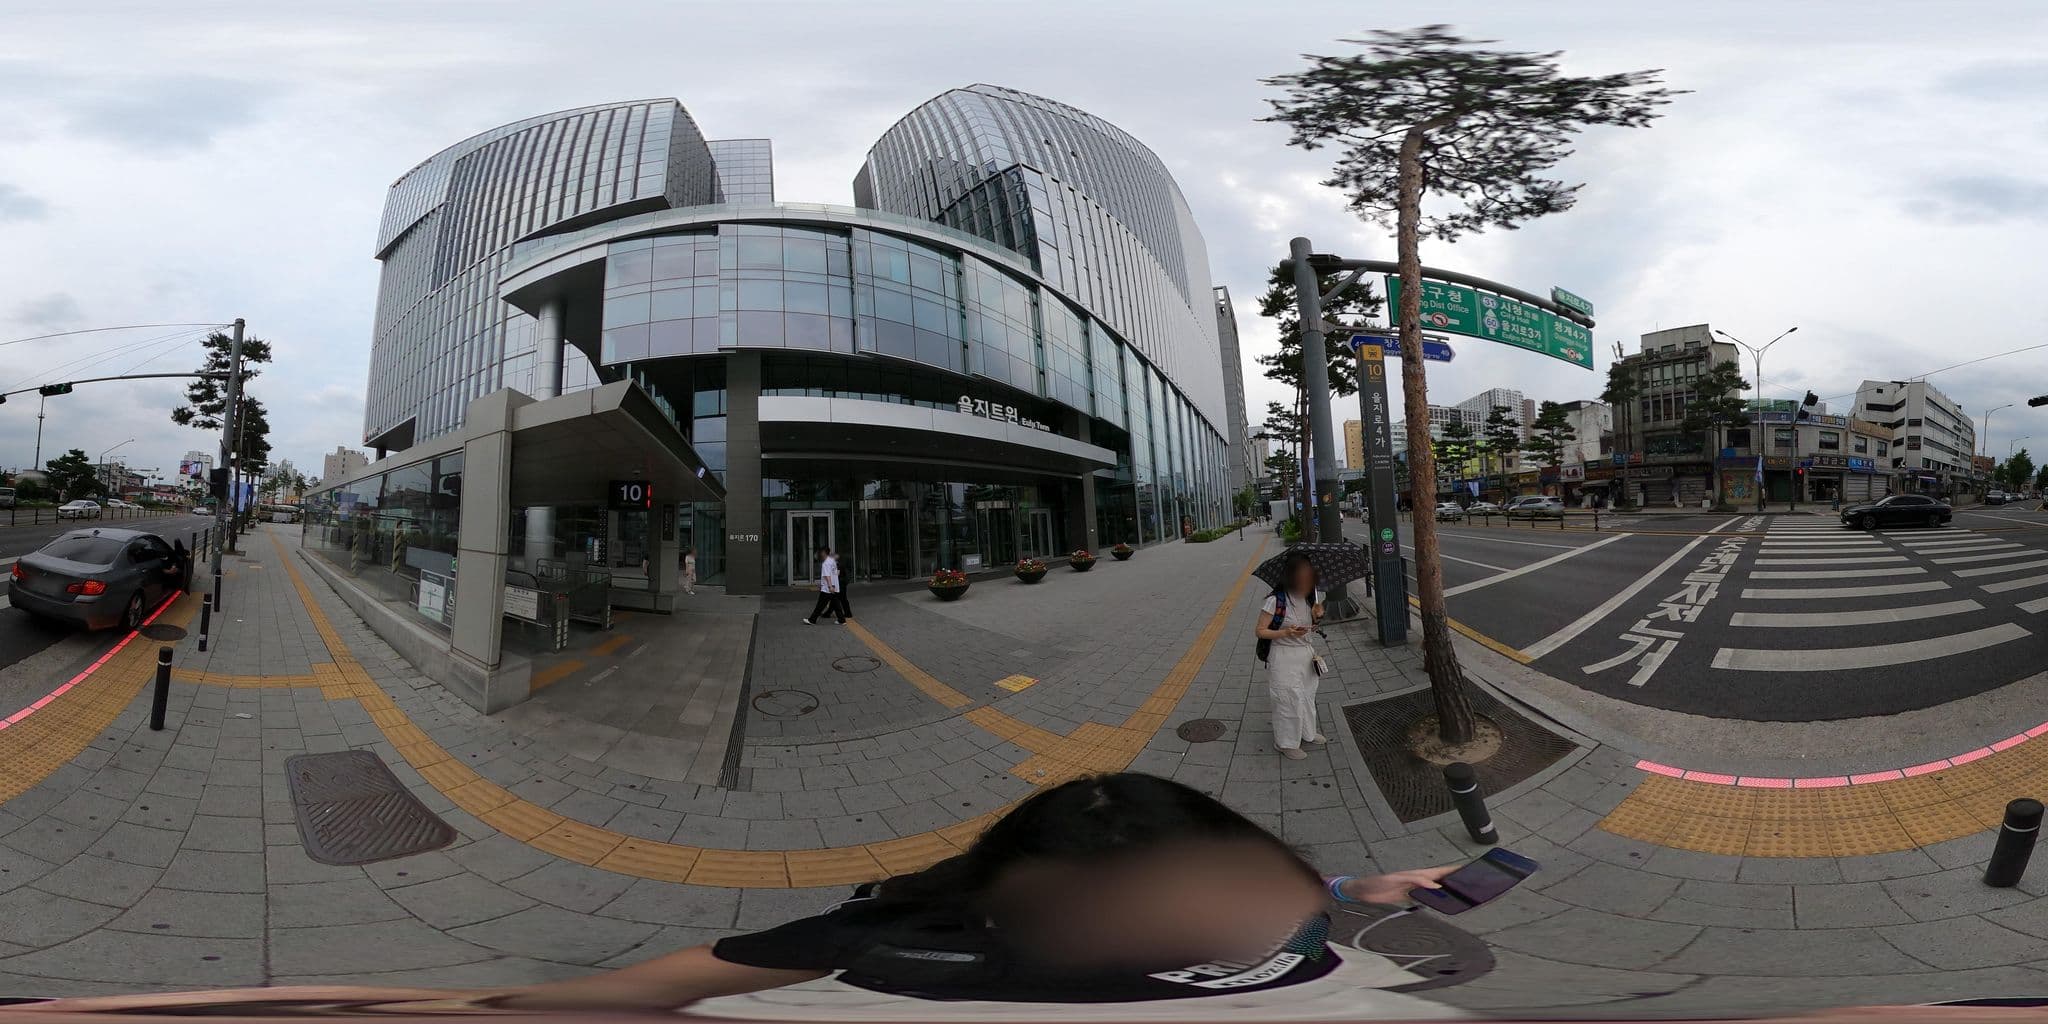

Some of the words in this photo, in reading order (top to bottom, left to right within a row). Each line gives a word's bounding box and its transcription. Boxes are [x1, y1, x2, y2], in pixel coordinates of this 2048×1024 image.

[1446, 302, 1470, 314] Office
[1501, 302, 1522, 316] 시청
[1502, 319, 1541, 341] 을지로3가
[1554, 321, 1587, 343] 청계4가
[1367, 364, 1382, 376] 10
[958, 395, 1018, 425] 을지트윈
[1372, 392, 1386, 448] 을지로4가
[620, 485, 642, 501] 10
[745, 534, 759, 542] 170
[1216, 954, 1298, 987] mozilla
